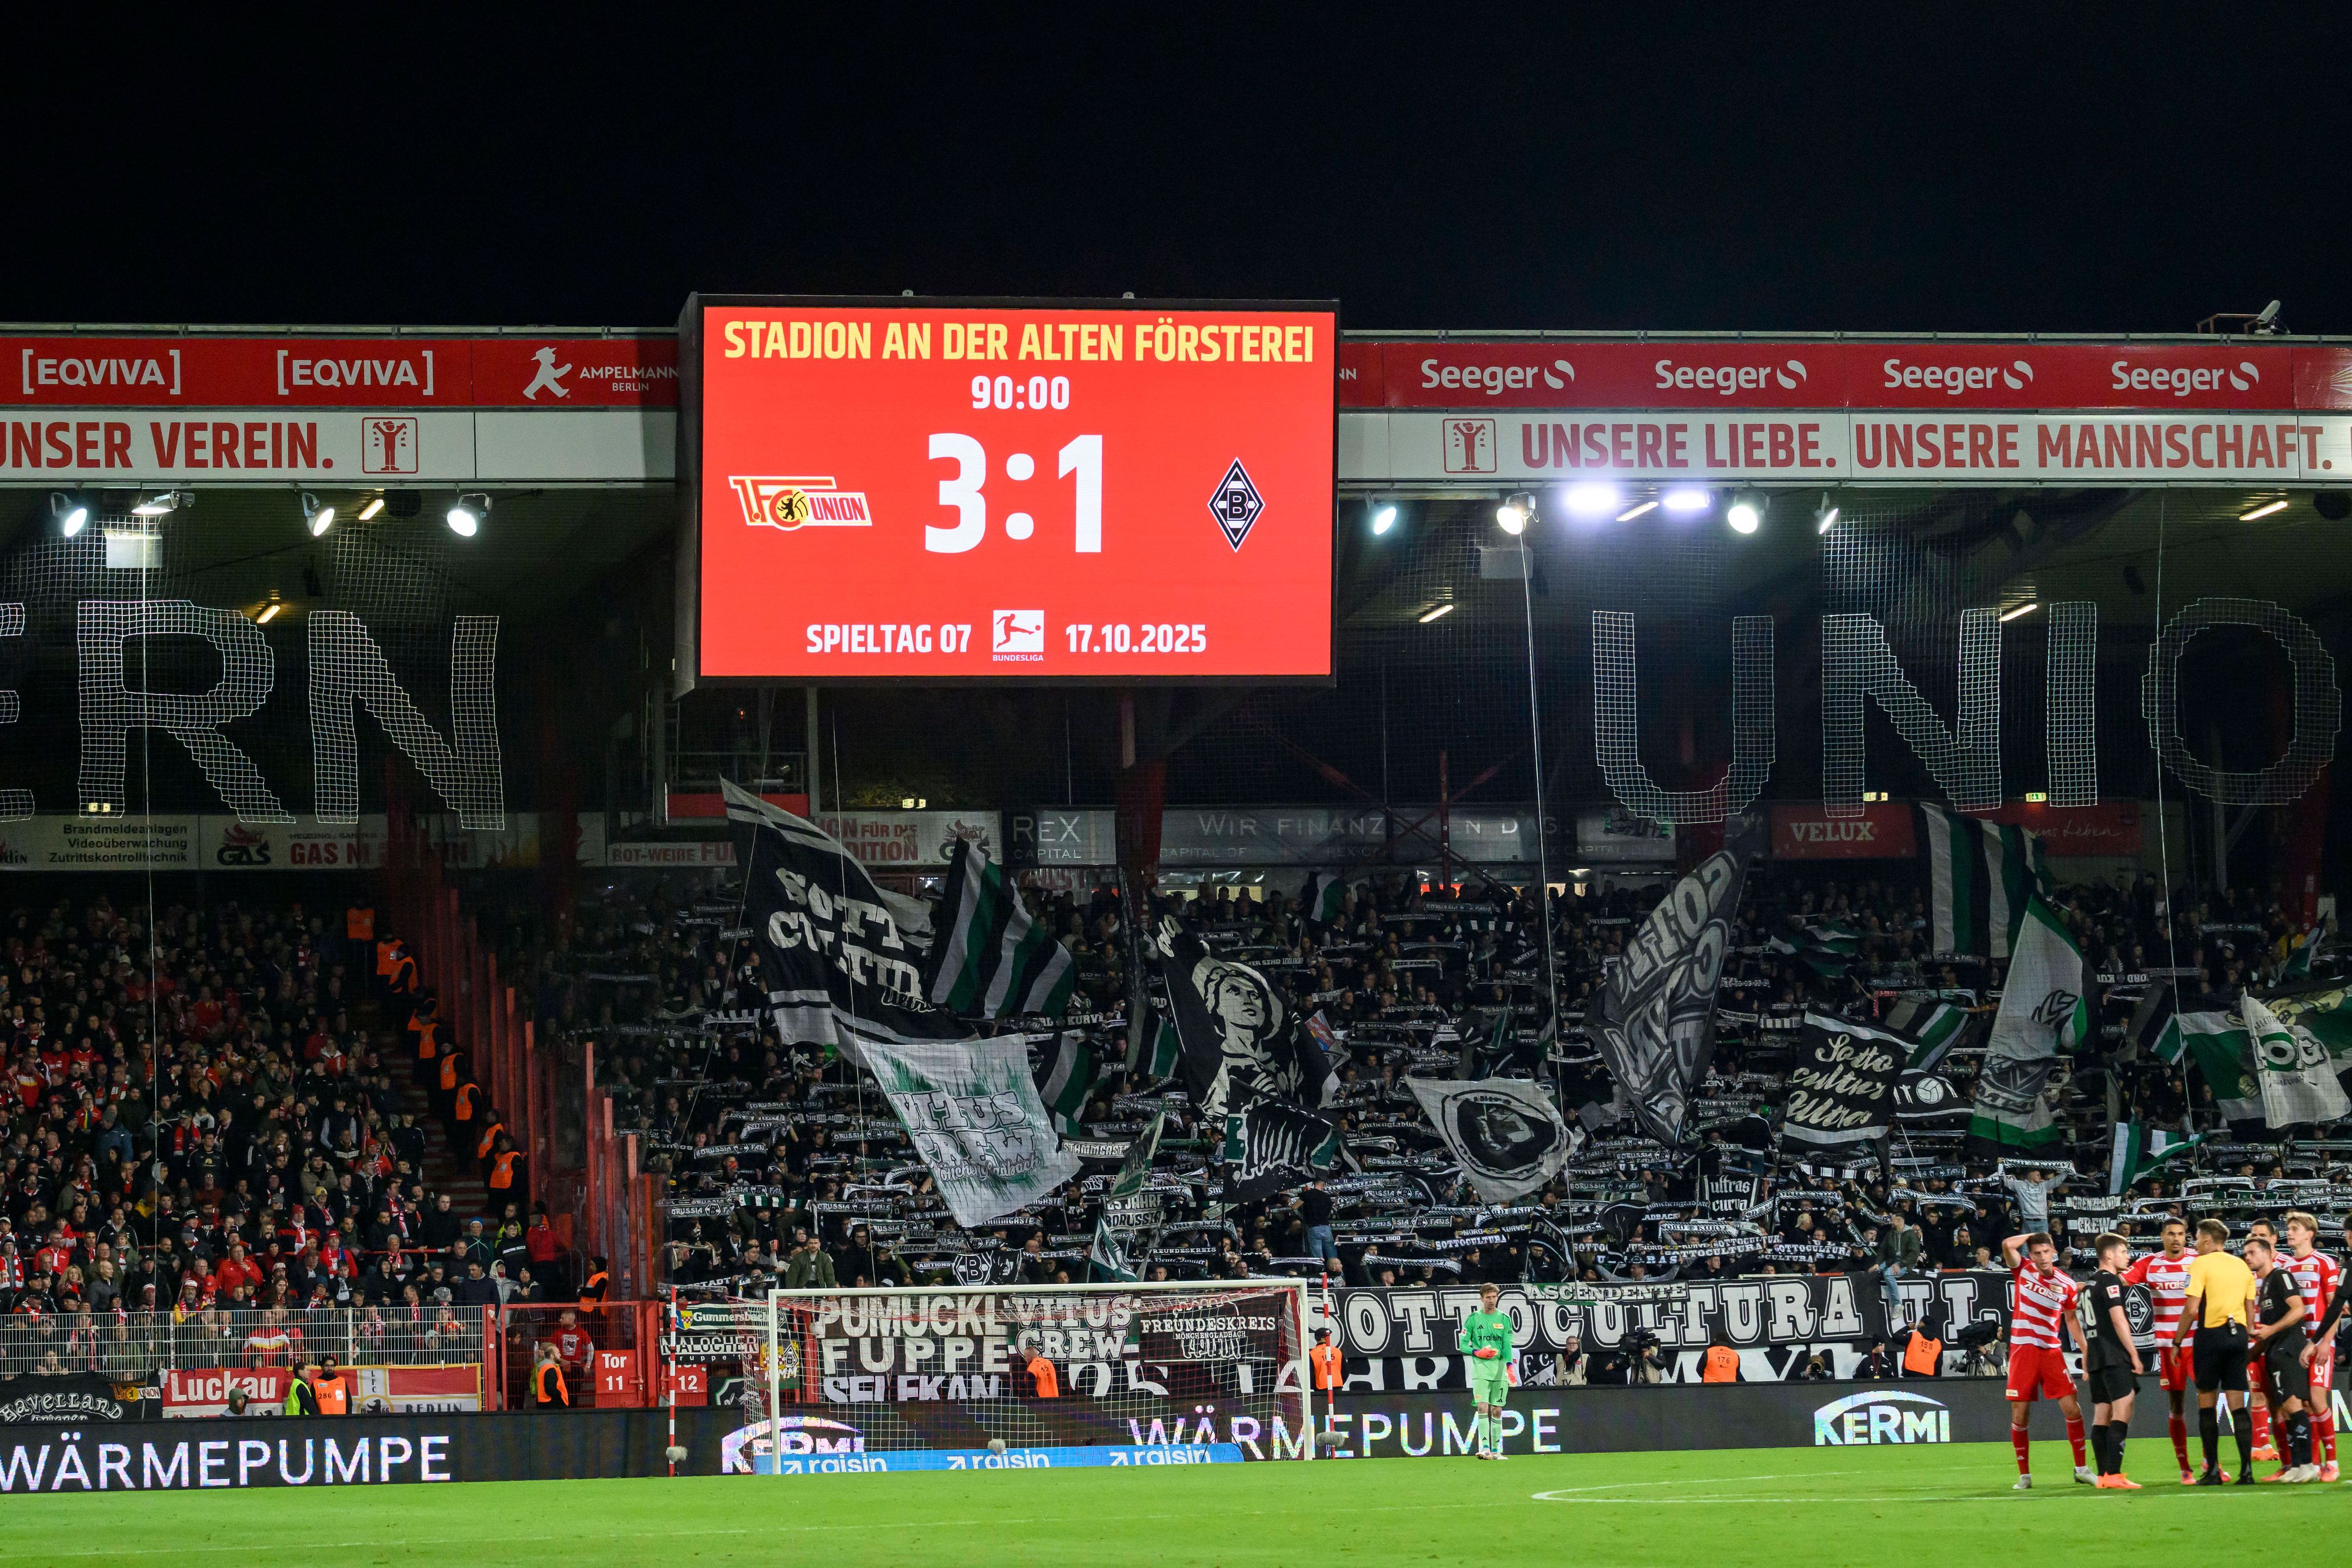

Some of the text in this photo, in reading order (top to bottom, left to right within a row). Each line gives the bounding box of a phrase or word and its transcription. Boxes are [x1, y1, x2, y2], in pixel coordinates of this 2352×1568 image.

[724, 317, 1314, 363] STADION AN DER ALTEN FÖRSTEREI
[612, 383, 649, 392] BERLIN
[1421, 359, 1538, 395] Seeger
[1655, 359, 1772, 396] Seeger
[1883, 359, 1999, 396] Seeger
[2112, 360, 2226, 397] Seeger
[971, 376, 1070, 410] 90:00
[0, 422, 334, 469] NSER VEREIN.
[1522, 423, 1836, 469] UNSERE LIEBE.
[1855, 424, 2333, 470] UNSERE MANNSCHAFT.
[812, 496, 866, 521] UNION
[806, 624, 1207, 654] SPIELTAG 07 17.10.2025
[63, 823, 187, 836] Brandmeldeanlagen
[1790, 822, 1874, 842] VELUX
[68, 837, 188, 850] Videoüberwachung
[290, 843, 338, 864] GAS
[939, 842, 992, 861] GS
[1014, 848, 1081, 859] CAPITAL
[49, 852, 188, 863] Zutrittskontrolltechnik
[1709, 1175, 1750, 1193] ultras
[2077, 1216, 2111, 1233] CREW
[1435, 1234, 1507, 1251] SOTTOCULTURA
[1528, 1281, 1689, 1303] ASCENDENTE
[816, 1295, 1008, 1338] PUMUCKL
[1009, 1294, 1134, 1328] VITUS
[1140, 1316, 1276, 1333] FREUNDESKREIS
[1175, 1330, 1247, 1340] MÖNCHENGLADBACH
[1014, 1327, 1128, 1362] CREW
[1919, 1342, 1934, 1350] 158
[603, 1354, 627, 1369] Tor
[821, 1336, 1010, 1375] FUPPE
[1716, 1356, 1730, 1364] 176
[171, 1370, 276, 1403] Luckau
[606, 1376, 623, 1391] 11
[677, 1375, 698, 1390] 12
[1815, 1390, 1950, 1446] KERMI
[0, 1431, 452, 1491] WÄRMEPUMPE
[809, 1453, 888, 1472] raisin
[972, 1449, 1051, 1469] raisin
[1133, 1445, 1211, 1466] raisin
